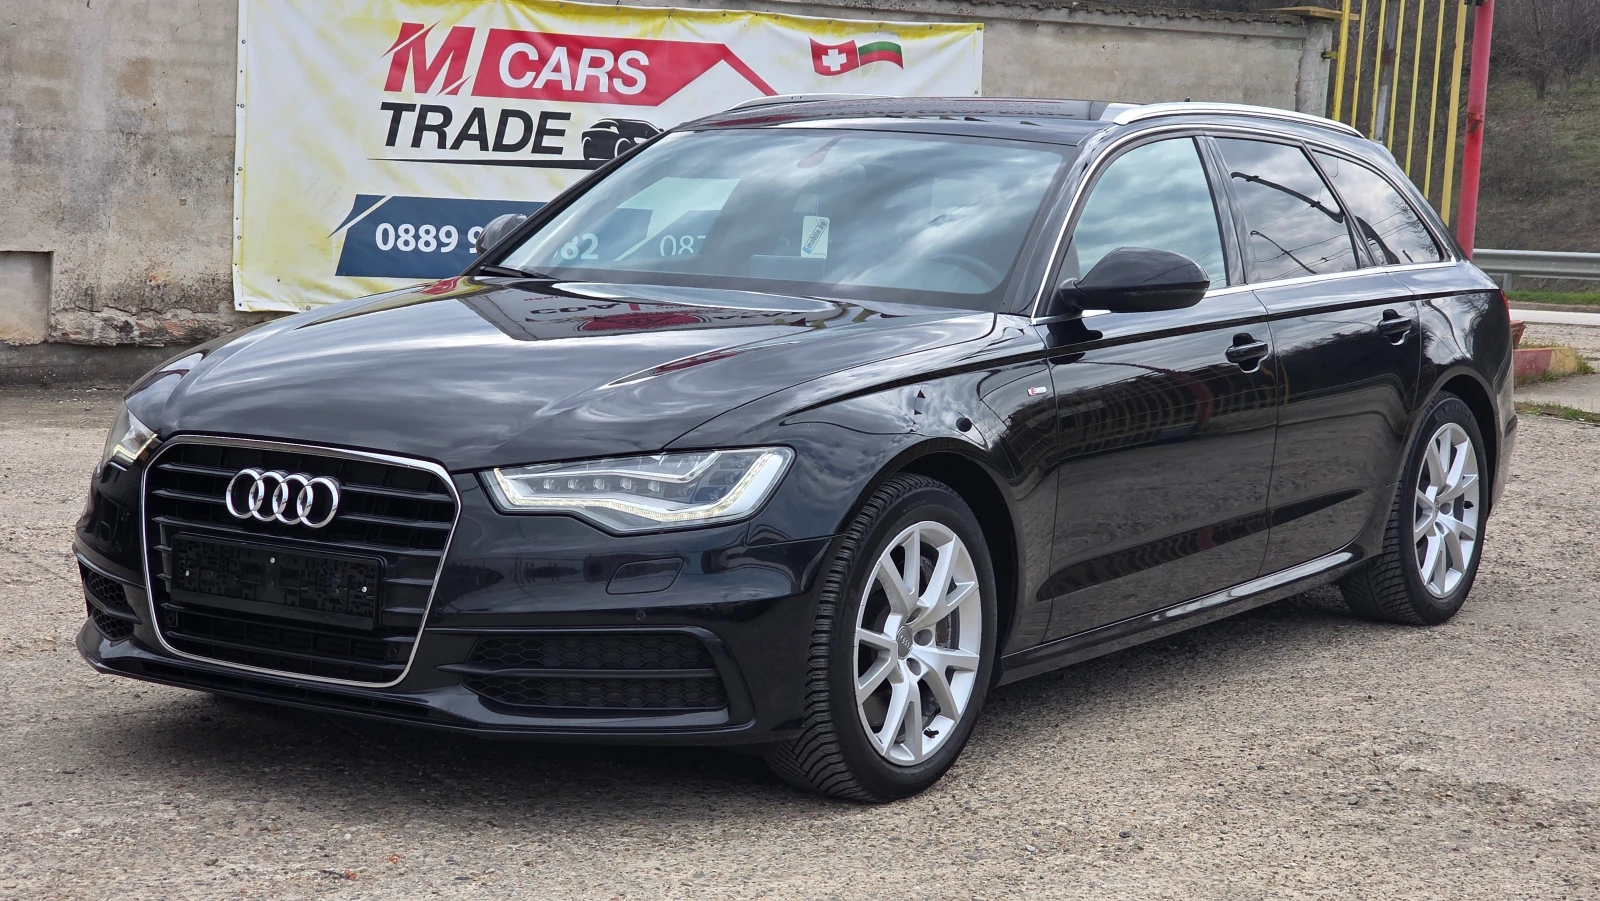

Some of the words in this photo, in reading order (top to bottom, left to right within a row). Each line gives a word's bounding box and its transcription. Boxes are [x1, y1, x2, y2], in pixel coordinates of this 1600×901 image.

[381, 20, 476, 97] M
[499, 42, 650, 95] CARS
[380, 101, 572, 155] TRADE
[375, 222, 459, 253] 0889
[553, 232, 599, 260] 82
